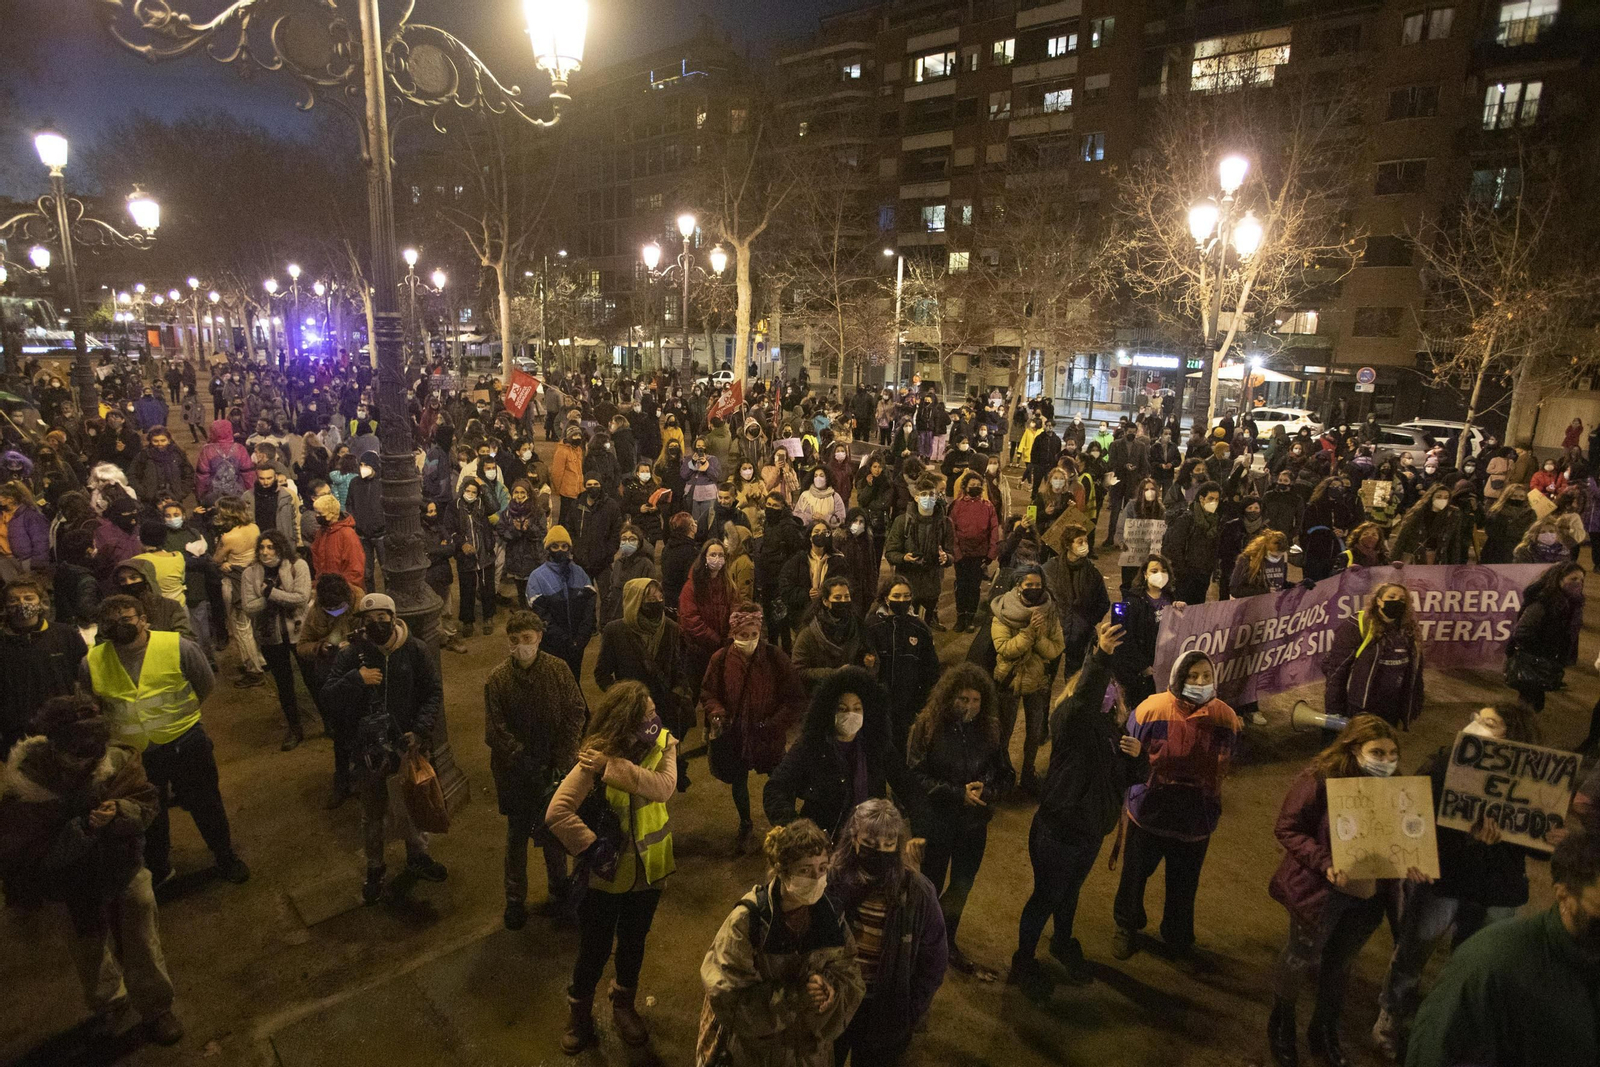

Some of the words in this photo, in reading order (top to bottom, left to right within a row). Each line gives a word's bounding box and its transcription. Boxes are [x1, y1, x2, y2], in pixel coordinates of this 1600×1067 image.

[1180, 628, 1230, 656] CON
[1234, 600, 1330, 650] DERECHOS,
[1410, 590, 1521, 612] ARRERA
[1216, 636, 1304, 684] MINISTAS
[1418, 620, 1512, 642] TERAS
[1485, 774, 1529, 804] EL
[1389, 844, 1420, 865] 8M
